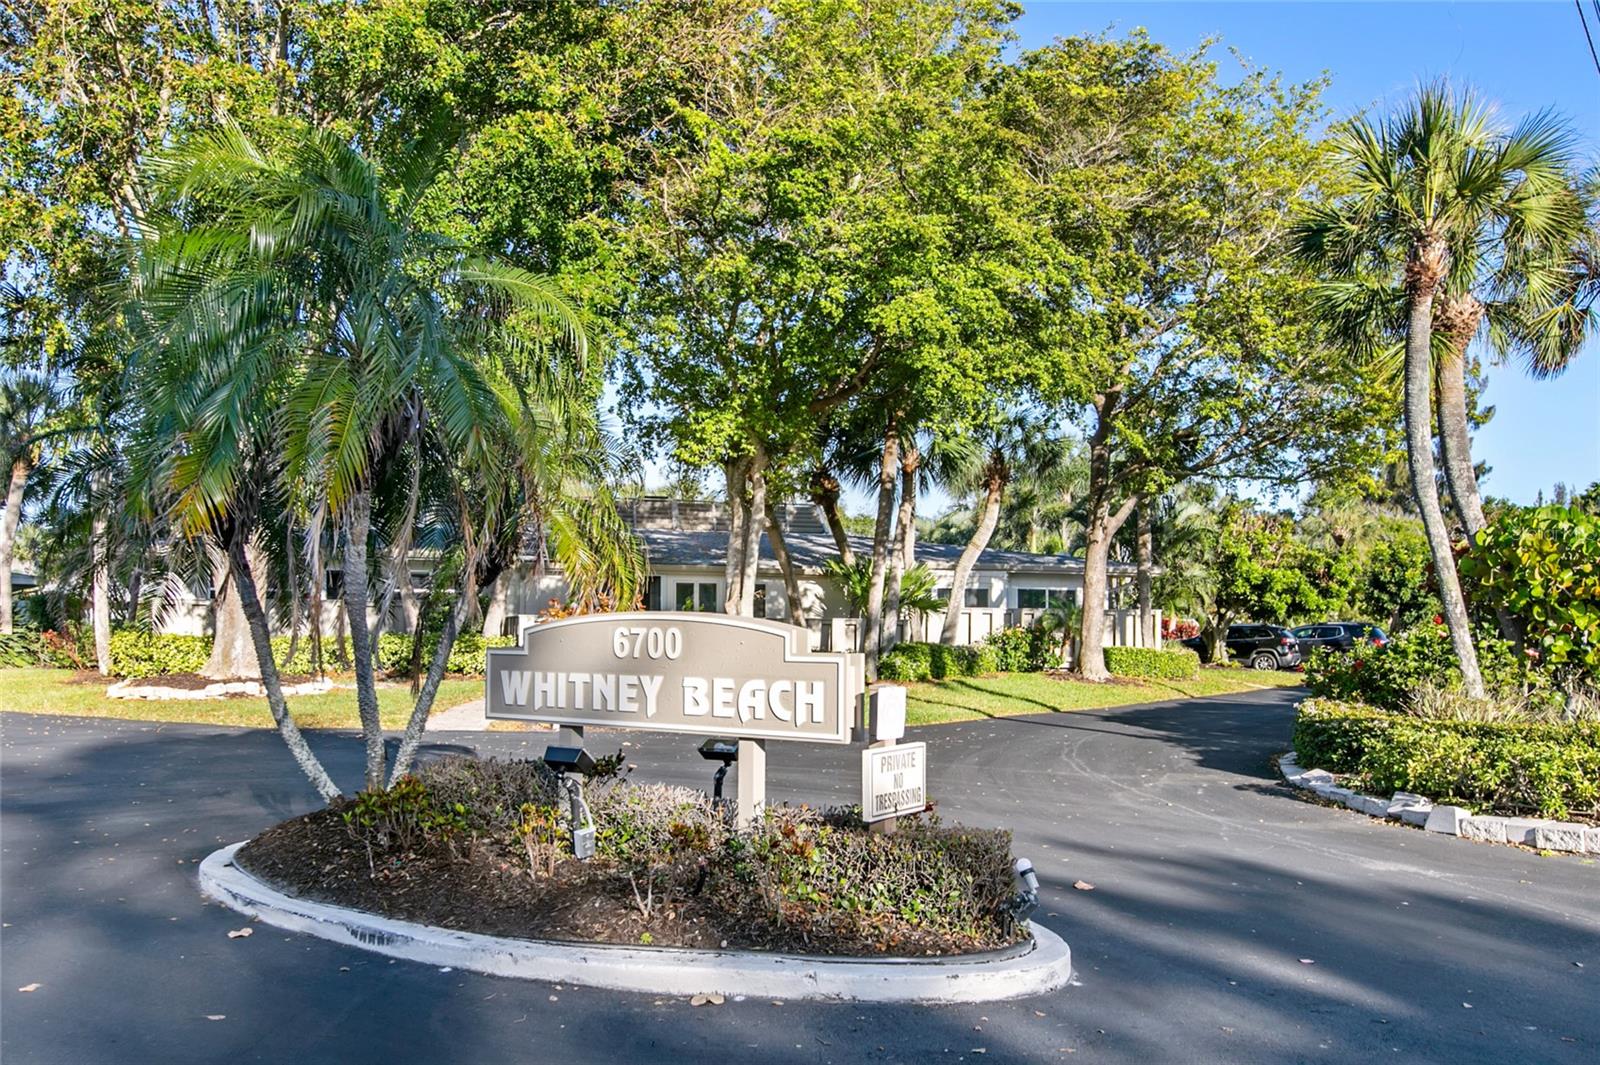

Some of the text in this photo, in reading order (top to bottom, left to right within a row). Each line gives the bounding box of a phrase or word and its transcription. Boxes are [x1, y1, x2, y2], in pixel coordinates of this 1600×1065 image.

[613, 627, 682, 660] 6700
[500, 670, 825, 728] WHITNEY BEACH
[880, 752, 916, 774] PRIVATE
[893, 772, 904, 789] NO
[875, 786, 921, 812] TRESPASSING
